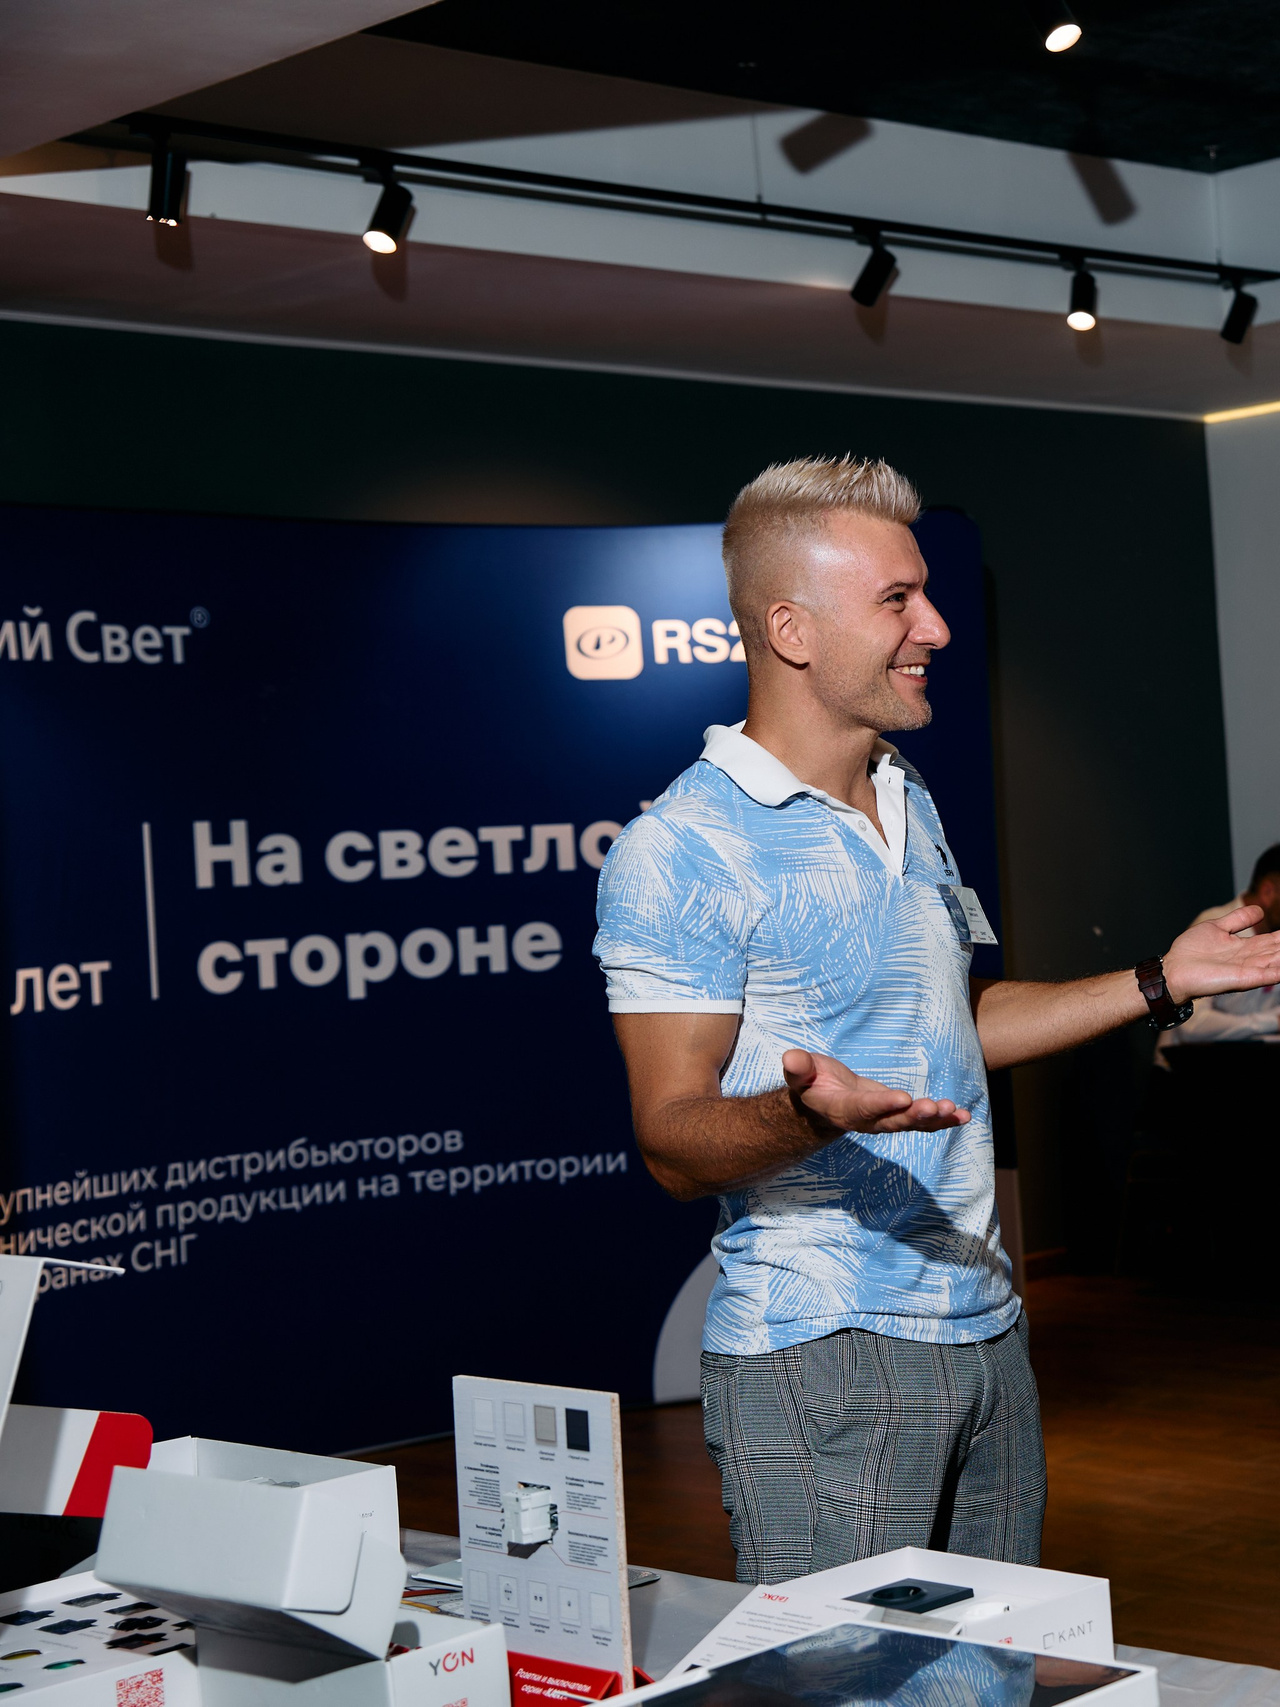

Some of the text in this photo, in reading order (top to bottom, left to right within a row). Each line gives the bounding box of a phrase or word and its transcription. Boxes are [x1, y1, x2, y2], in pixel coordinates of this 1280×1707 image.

[192, 800, 653, 889] На светло
[10, 960, 112, 1016] лет
[197, 920, 563, 1001] стороне
[0, 1130, 464, 1226] упнейших дистрибьюторов
[156, 1179, 347, 1231] продукции
[357, 1173, 400, 1199] на
[408, 1151, 628, 1196] территории
[131, 1233, 199, 1274] СНГ
[1057, 1620, 1094, 1643] KANT
[515, 1668, 542, 1682] Розетки
[546, 1676, 592, 1693] выключатели
